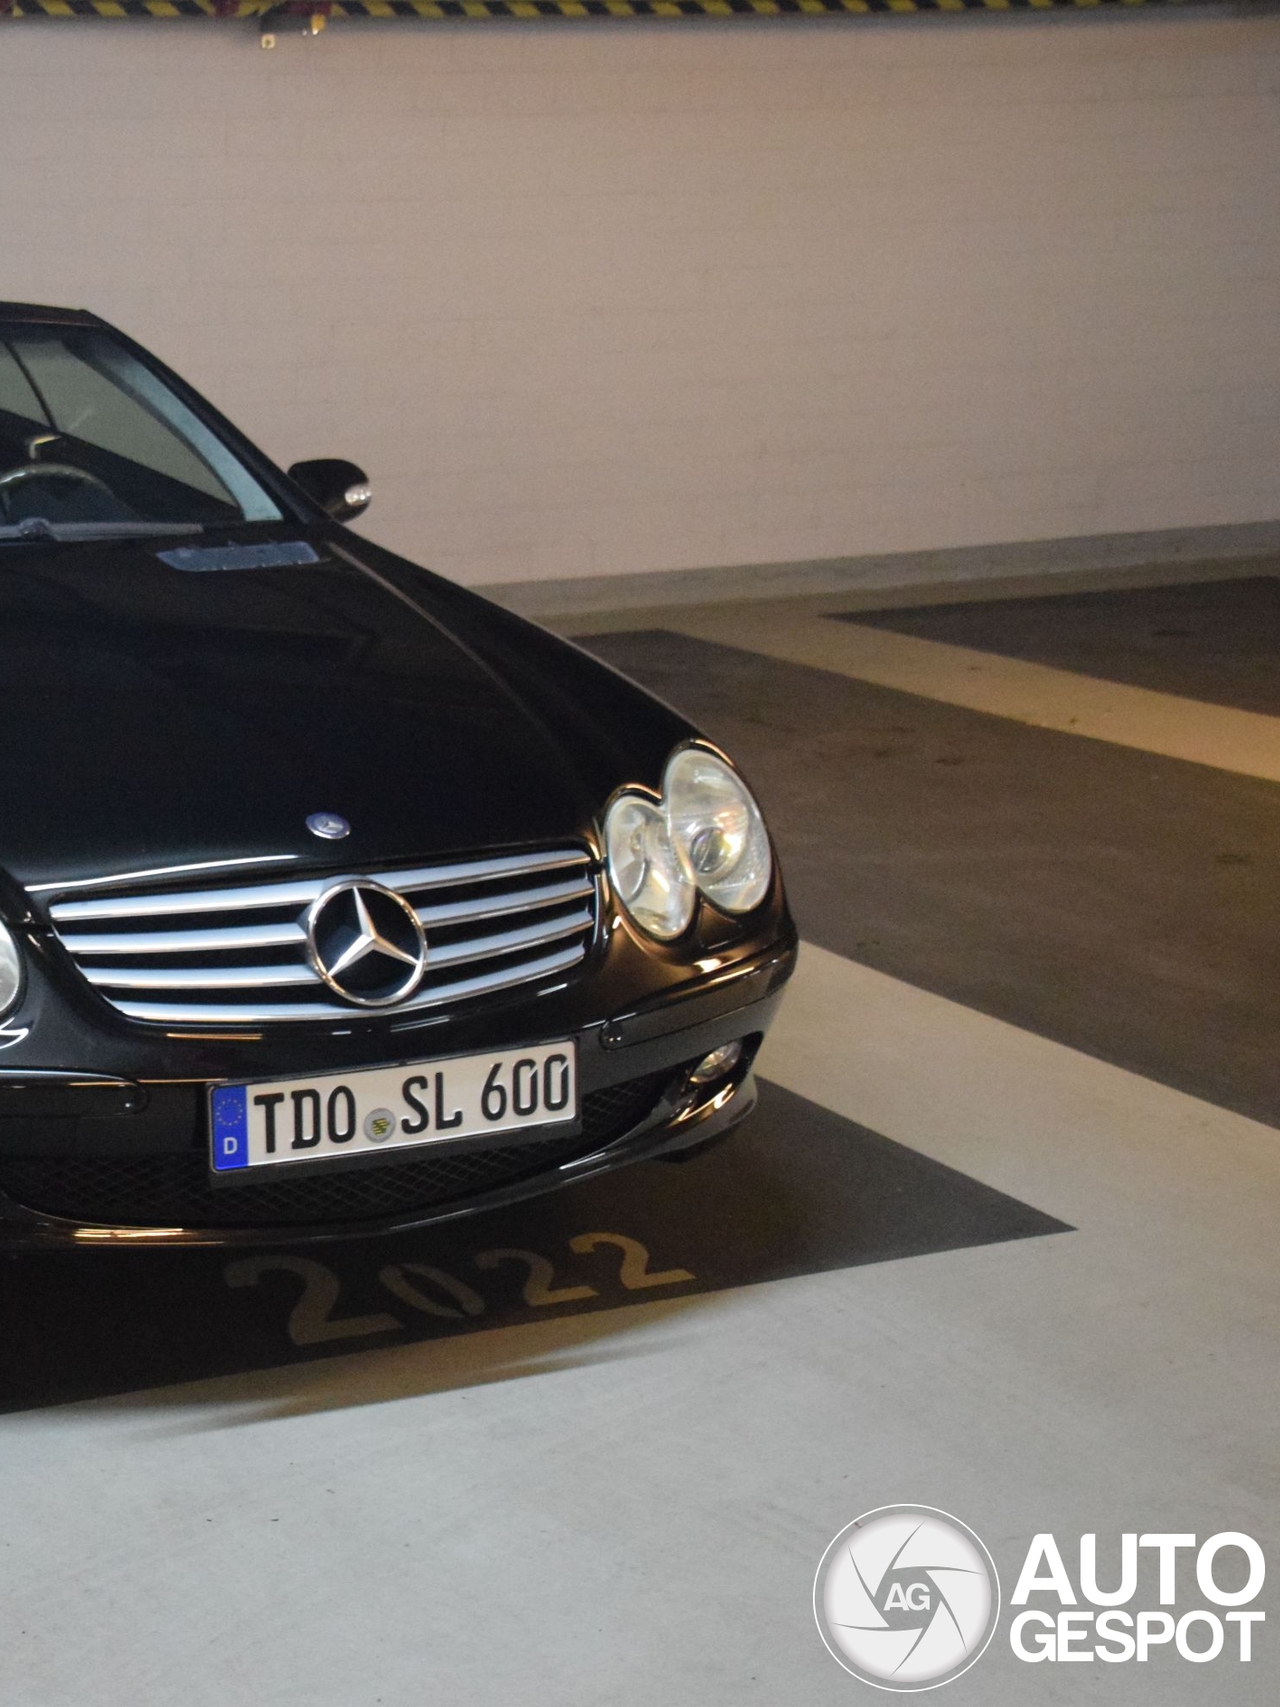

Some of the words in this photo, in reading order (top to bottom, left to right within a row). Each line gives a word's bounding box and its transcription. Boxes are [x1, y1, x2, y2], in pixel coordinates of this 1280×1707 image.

[223, 1136, 237, 1155] D
[254, 1085, 356, 1153] TDO
[400, 1072, 463, 1134] SL
[481, 1053, 569, 1122] 600
[224, 1231, 696, 1345] 2022
